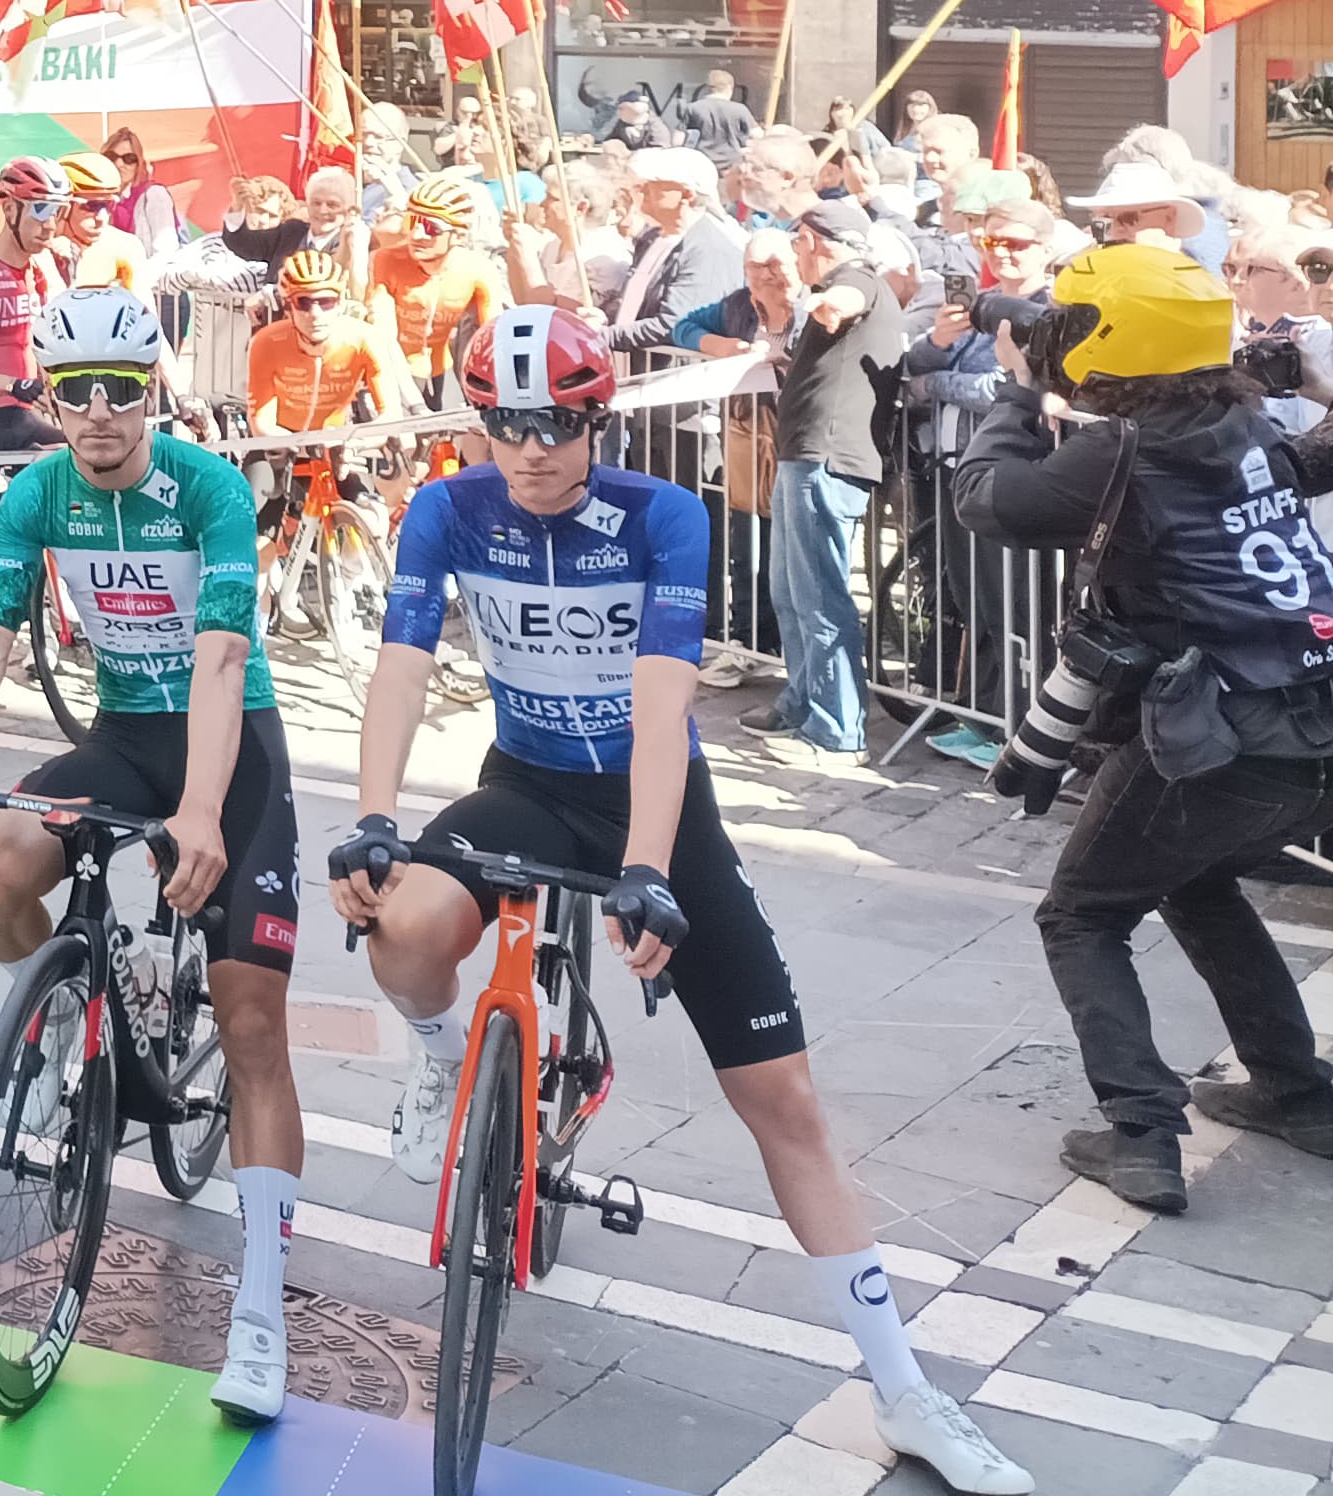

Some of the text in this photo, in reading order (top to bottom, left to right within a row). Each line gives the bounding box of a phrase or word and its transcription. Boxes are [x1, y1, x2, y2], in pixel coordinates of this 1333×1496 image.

[1222, 487, 1300, 535] STAFF
[68, 521, 104, 537] GOBIK
[1091, 522, 1108, 550] EOS
[488, 547, 532, 569] GOBIK
[90, 562, 169, 591] UAE
[101, 596, 168, 613] Emirates
[474, 590, 639, 640] INEOS
[102, 616, 184, 634] XRG
[109, 929, 151, 1058] COLNAGO
[750, 1010, 789, 1031] GOBIK
